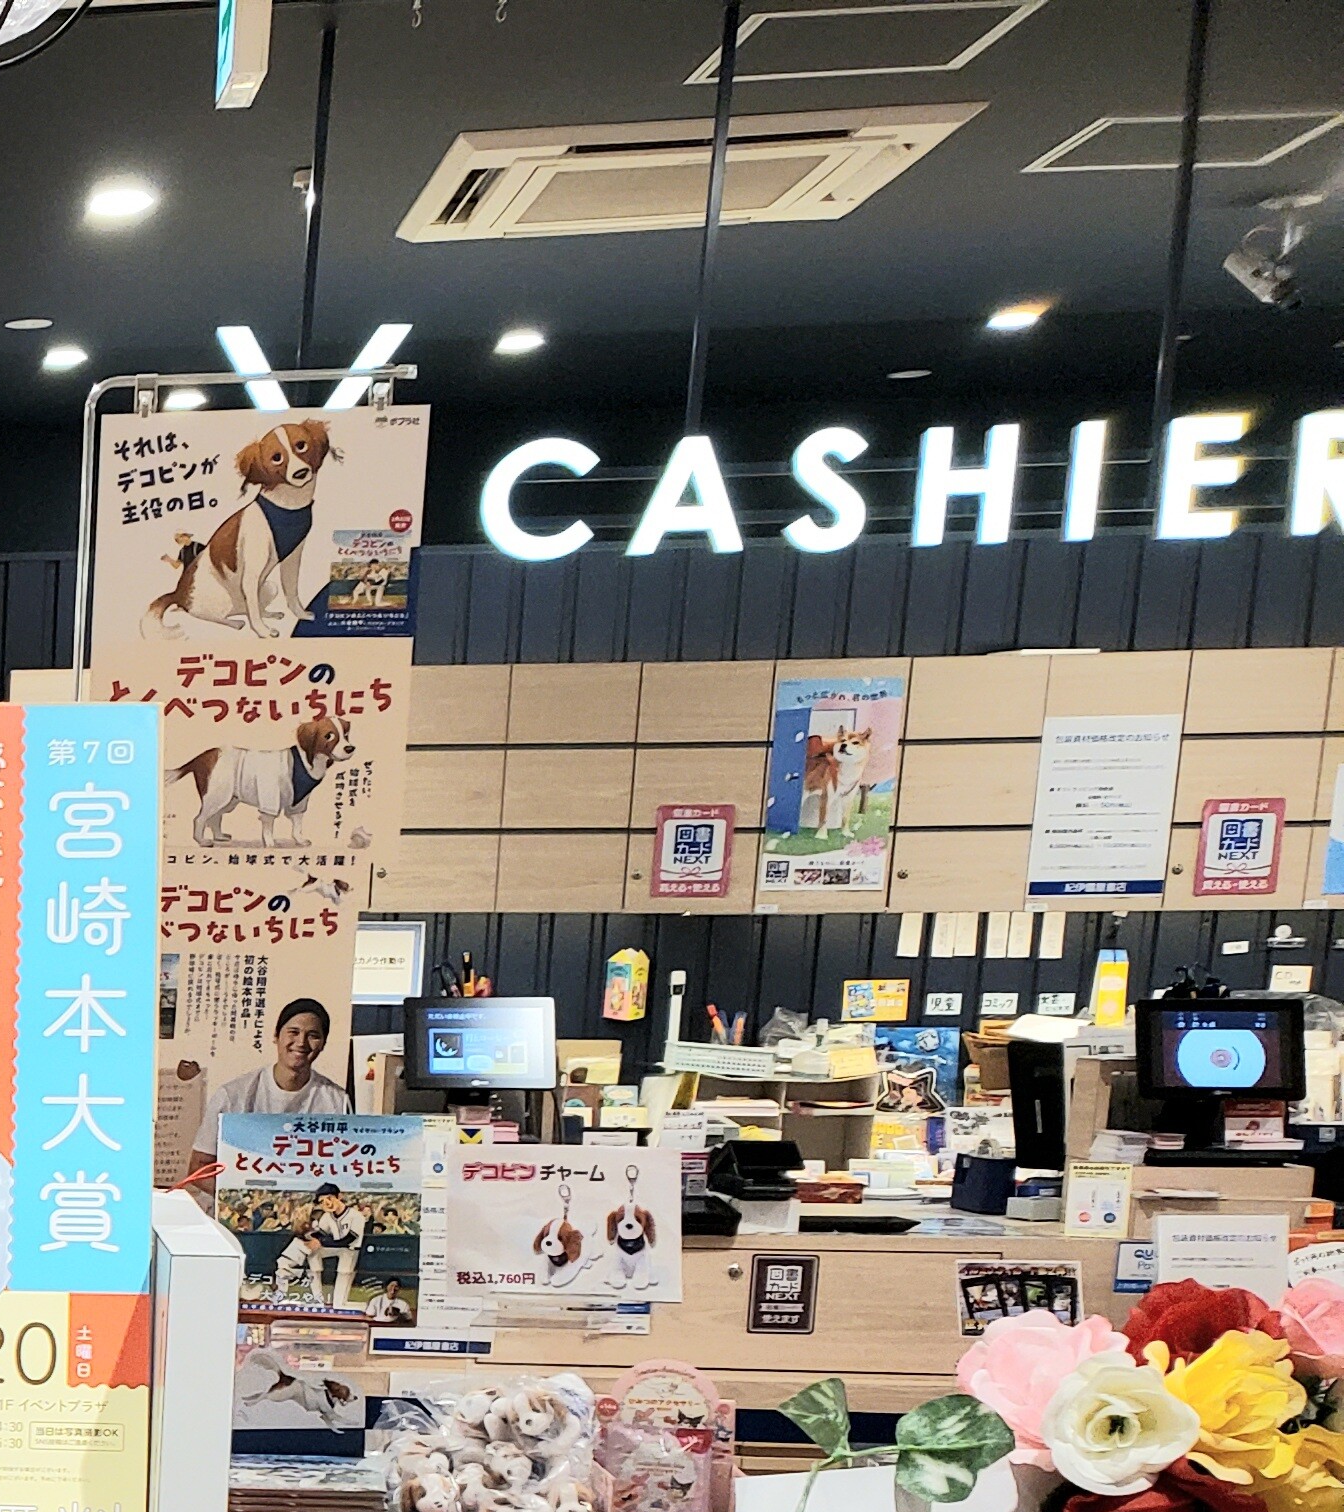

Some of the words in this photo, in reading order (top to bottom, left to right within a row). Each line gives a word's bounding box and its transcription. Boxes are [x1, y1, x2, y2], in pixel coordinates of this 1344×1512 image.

[114, 431, 189, 462] それは、
[117, 453, 221, 493] デコピンが
[478, 408, 1344, 562] CASHIER
[122, 490, 219, 525] 主役の日。
[176, 653, 336, 688] デコピンの
[46, 737, 135, 767] 第7回
[39, 783, 133, 1255] 宮崎本大賞
[272, 1134, 377, 1158] デコピンの
[235, 1153, 401, 1178] とくべつないちにち
[462, 1161, 536, 1183] デコピン
[540, 1162, 606, 1182] チャーム
[456, 1270, 536, 1286] 税込1,760円
[75, 1325, 93, 1379] 土曜日
